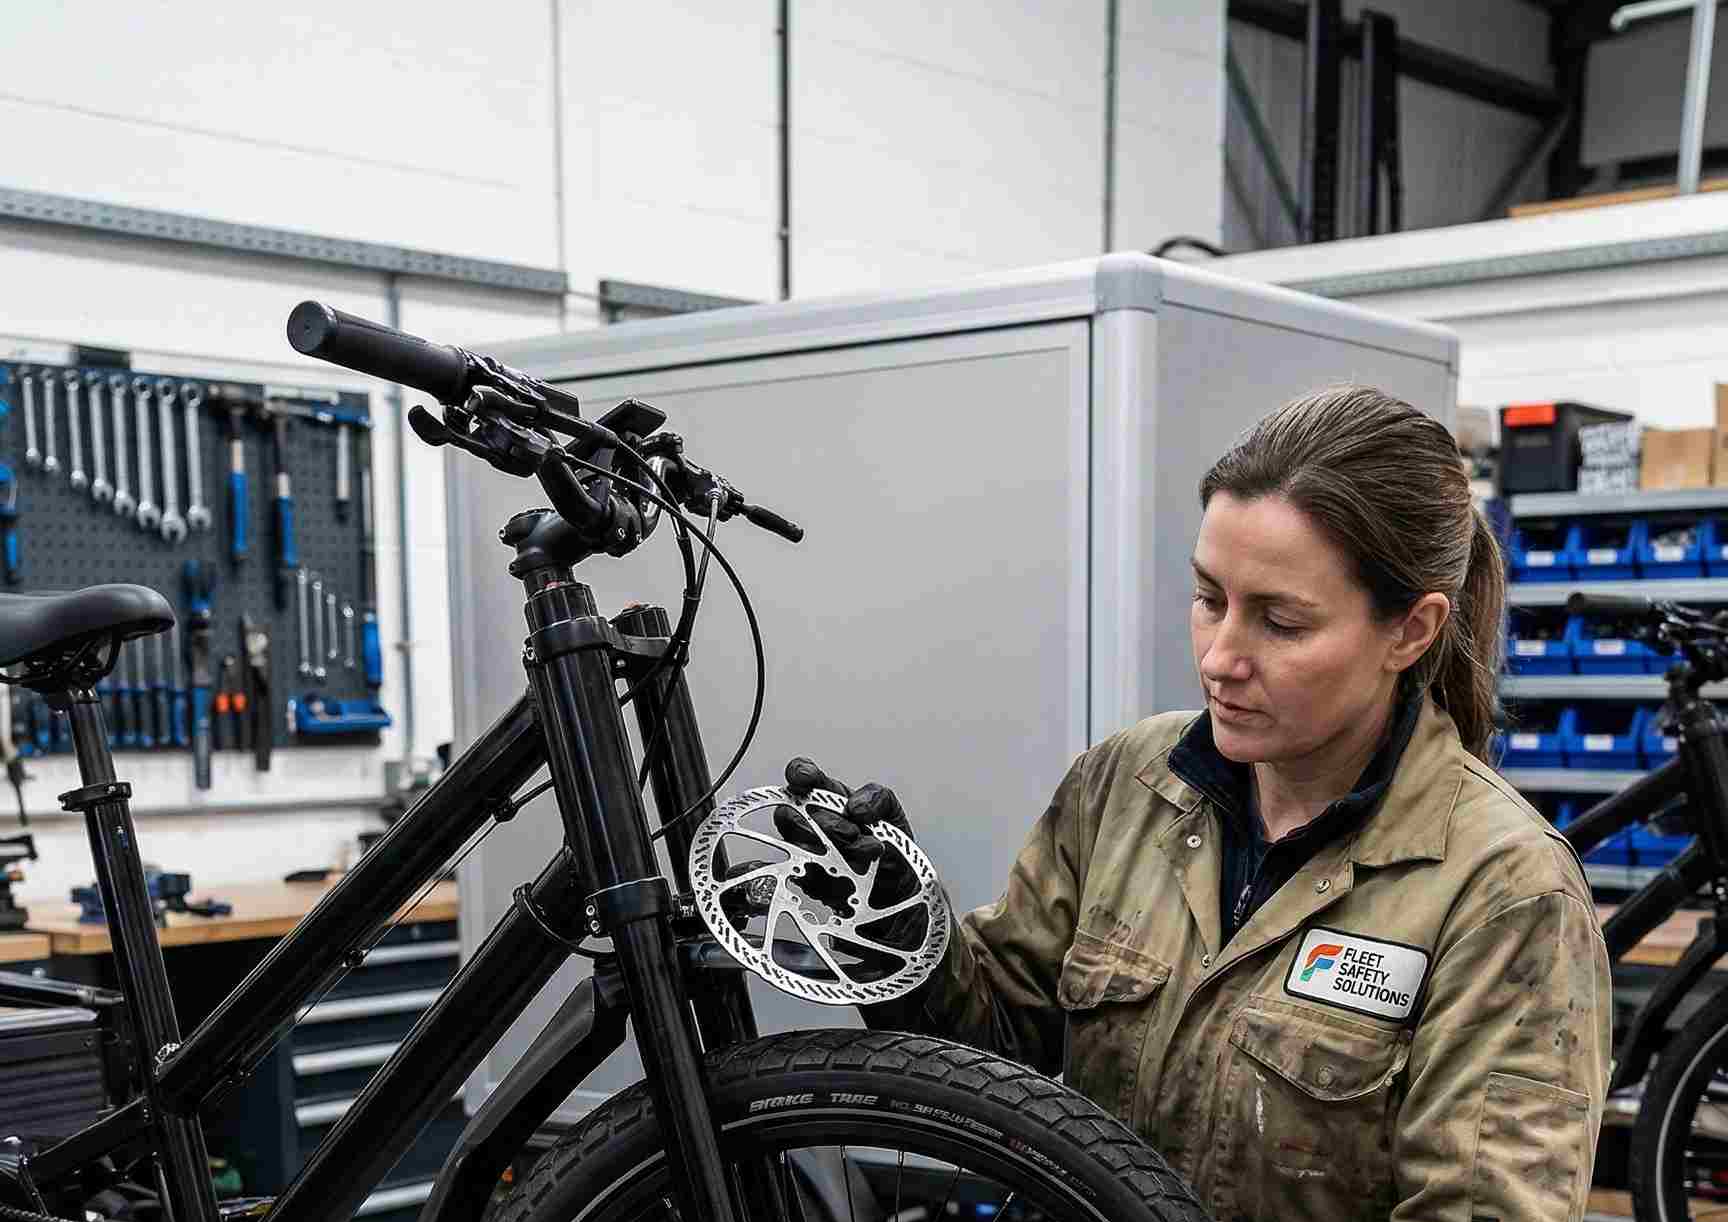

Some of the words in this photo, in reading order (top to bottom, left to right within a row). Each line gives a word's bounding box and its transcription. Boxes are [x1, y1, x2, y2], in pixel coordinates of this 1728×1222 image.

[1344, 947, 1384, 967] FLEET
[1338, 962, 1391, 986] SAFETY
[1333, 978, 1410, 1006] SOLUTIONS
